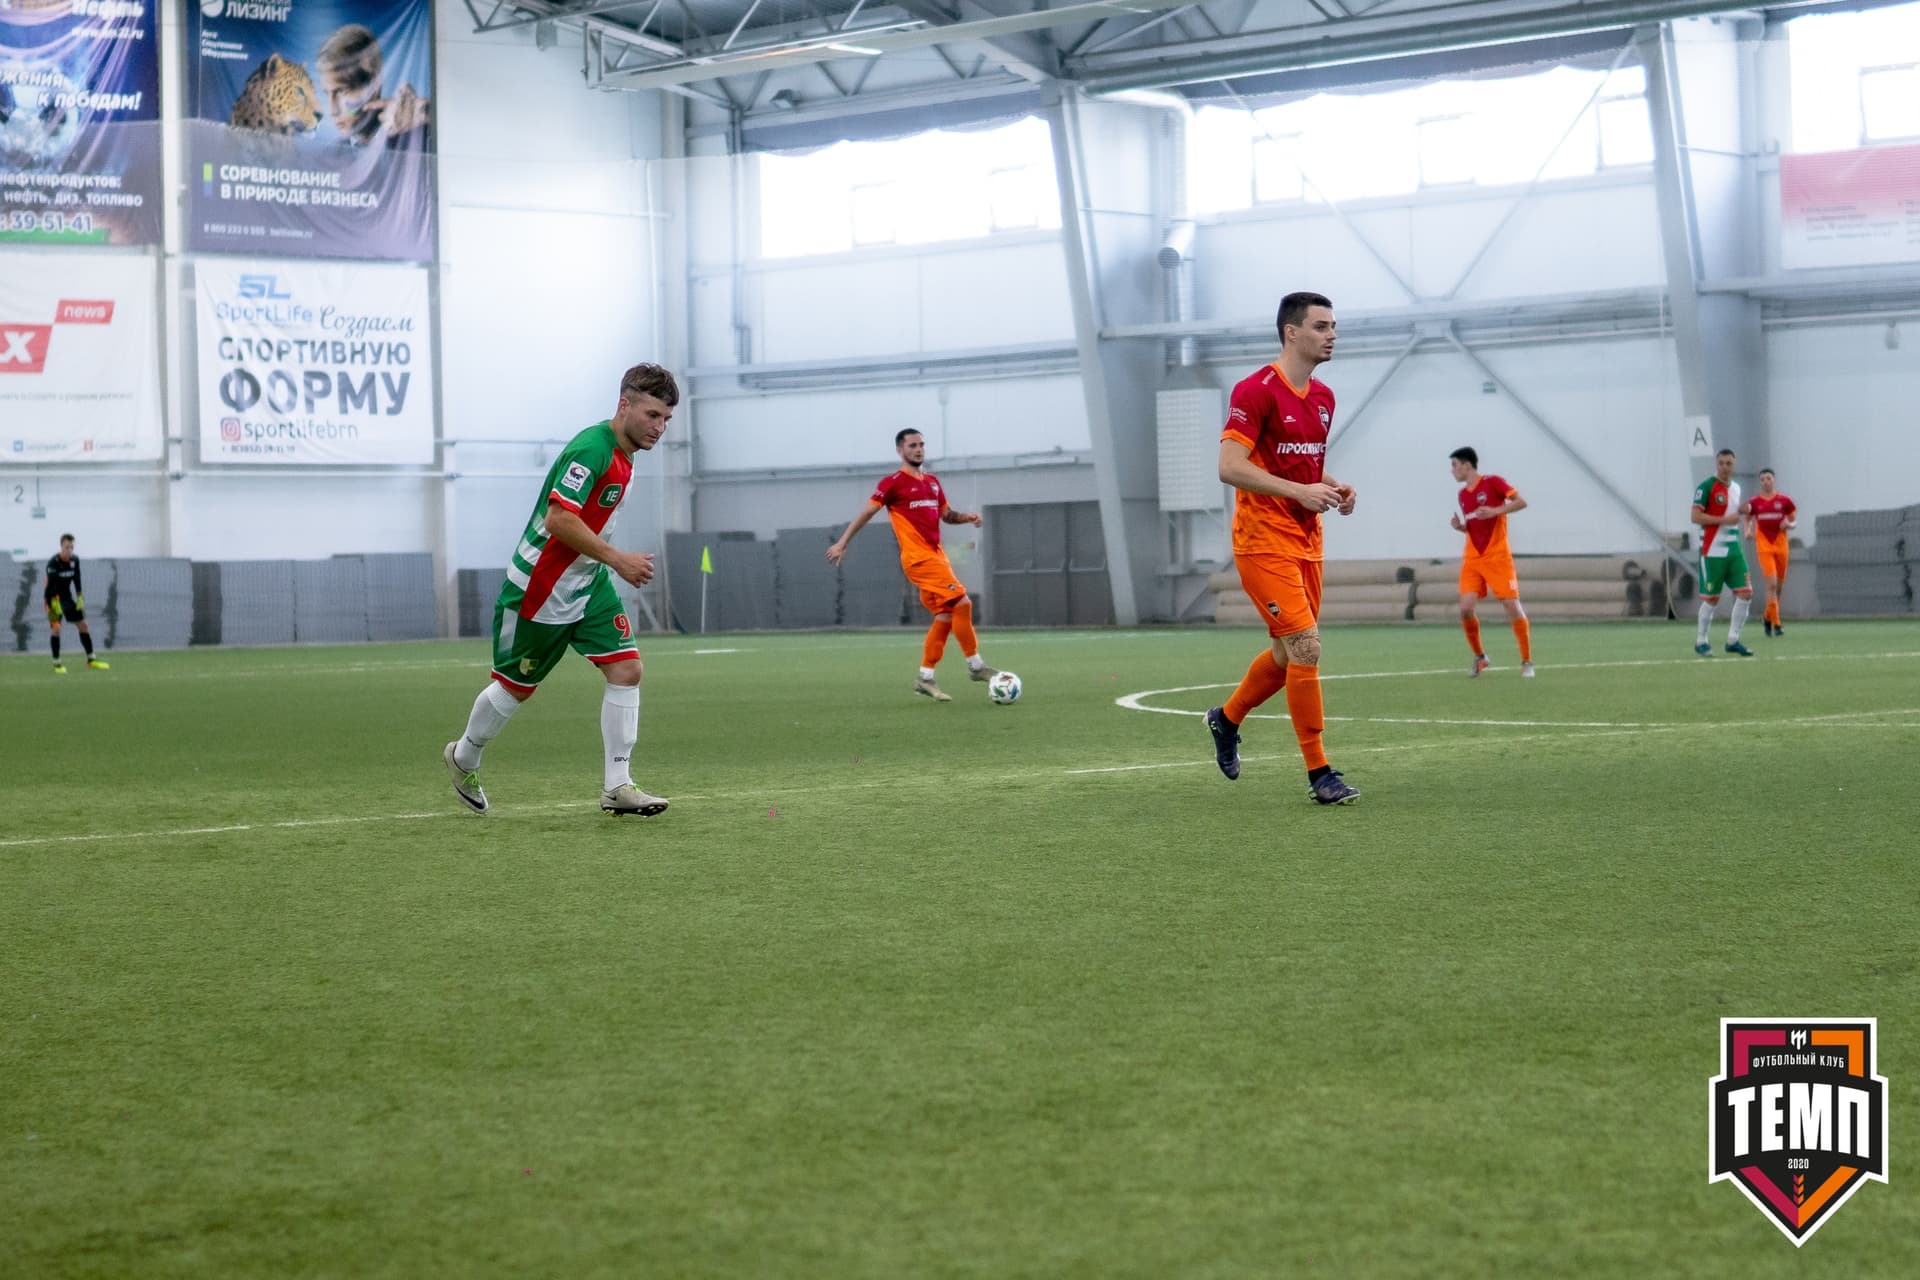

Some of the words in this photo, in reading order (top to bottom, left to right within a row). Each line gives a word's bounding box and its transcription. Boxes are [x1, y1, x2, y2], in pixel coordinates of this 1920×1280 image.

[225, 1, 291, 22] ЛИЗИНГ
[0, 71, 64, 87] жения
[220, 165, 341, 187] СОРЕВНОВАНИЕ
[86, 193, 143, 207] топливо
[221, 184, 231, 198] В
[235, 185, 308, 206] ПРИРОДЕ
[311, 190, 379, 208] БИЗНЕСА
[64, 305, 106, 318] news
[216, 303, 313, 323] SportLife
[320, 305, 415, 338] Создаем
[218, 336, 411, 365] СПОРТИВНУЮ
[219, 368, 411, 416] ФОРМУ
[14, 484, 24, 504] 2
[613, 613, 632, 640] 9
